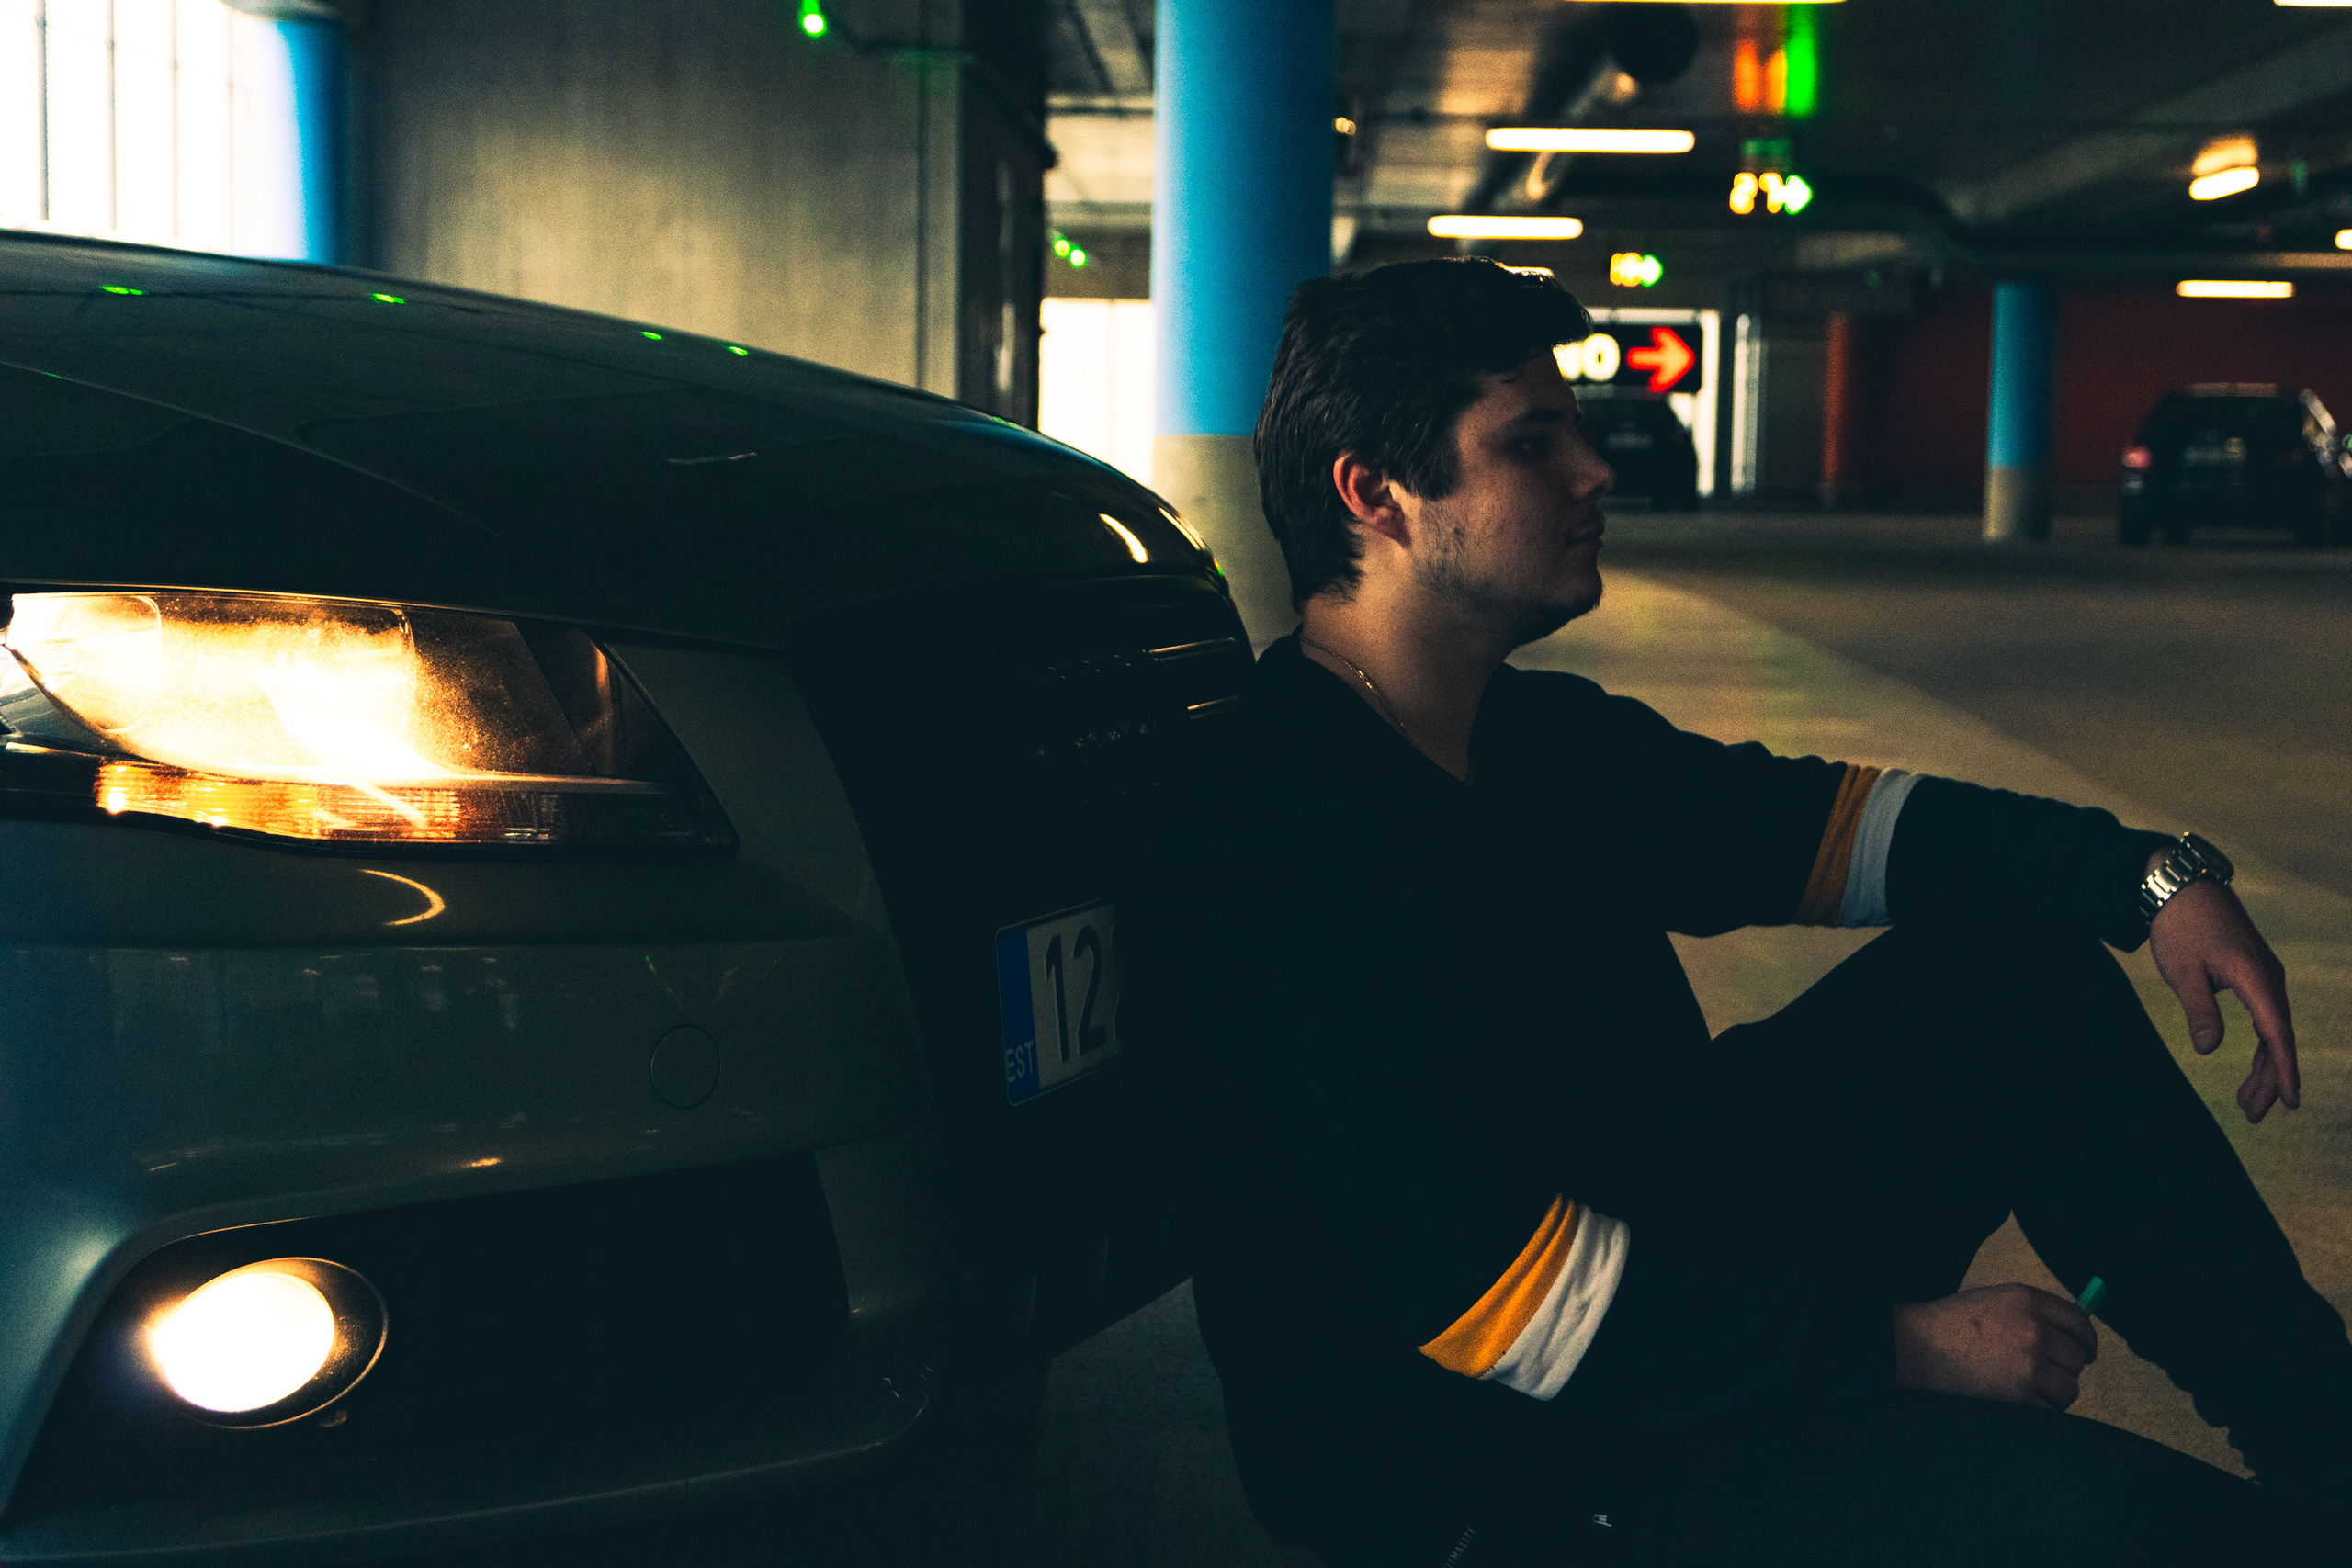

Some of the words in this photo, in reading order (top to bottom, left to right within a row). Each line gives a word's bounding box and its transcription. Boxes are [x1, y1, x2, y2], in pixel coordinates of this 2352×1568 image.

[1045, 925, 1115, 1063] 12
[1006, 1039, 1035, 1083] EST
[1442, 1526, 1477, 1568] LIMALITE
